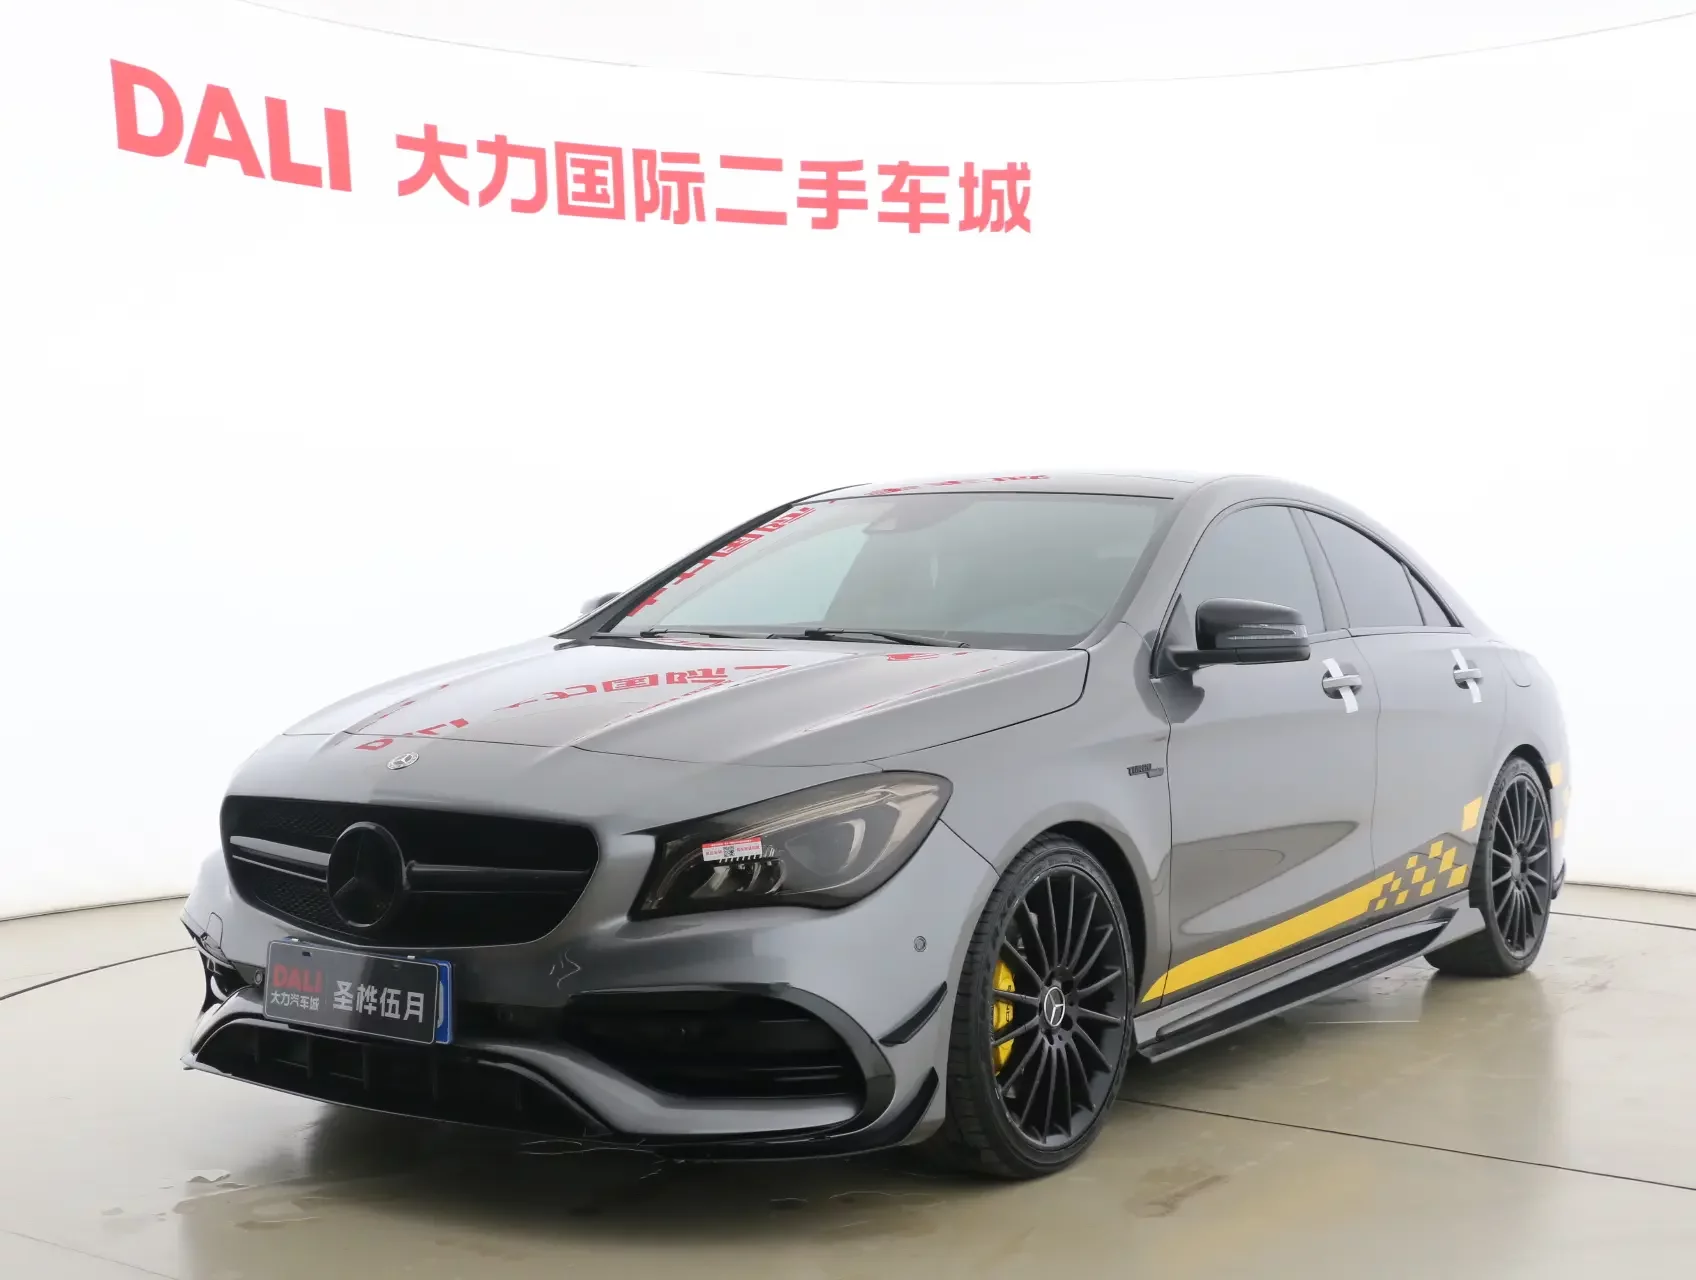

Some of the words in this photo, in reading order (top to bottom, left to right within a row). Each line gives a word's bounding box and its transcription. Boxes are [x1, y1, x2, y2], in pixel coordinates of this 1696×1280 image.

[110, 59, 353, 193] DALI
[395, 123, 1033, 234] 大力国际二手车城
[272, 963, 323, 993] DALI
[270, 991, 321, 1012] 大力汽车城
[332, 980, 426, 1024] 圣桦伍月
